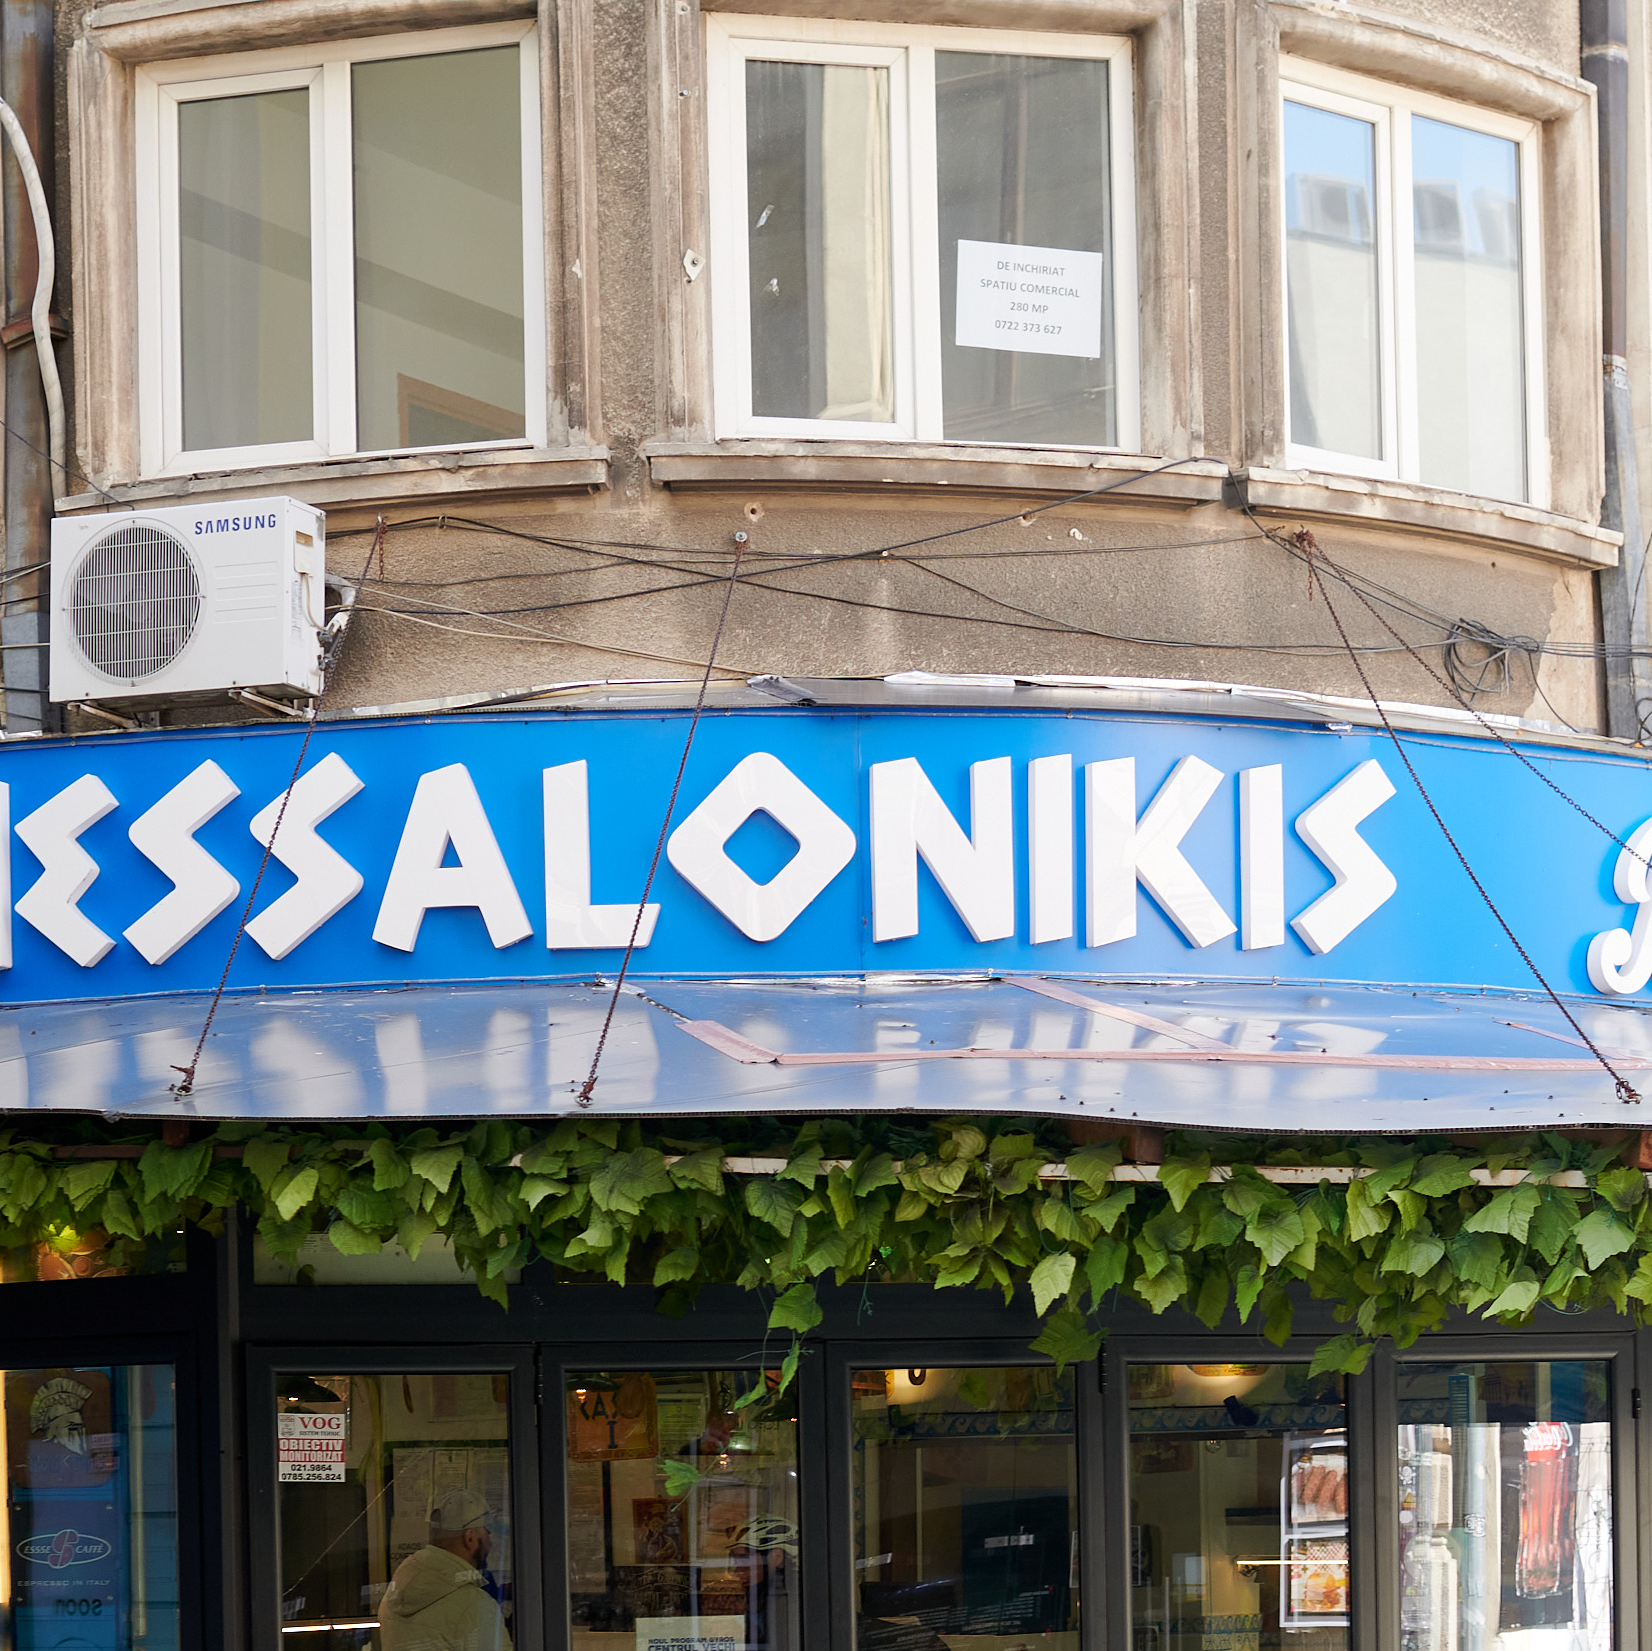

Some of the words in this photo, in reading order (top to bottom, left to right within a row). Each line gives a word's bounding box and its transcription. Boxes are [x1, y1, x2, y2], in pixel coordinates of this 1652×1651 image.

[997, 261, 1010, 271] DE
[1013, 263, 1065, 276] INCHIRIAT
[980, 279, 1017, 291] SPATIU
[1020, 283, 1080, 298] COMERCIAL
[1010, 302, 1029, 311] 280
[1032, 304, 1049, 314] MP
[995, 320, 1019, 330] 0722
[1022, 323, 1041, 332] 373
[1044, 325, 1062, 335] 627
[195, 514, 276, 535] SAMSUNG
[298, 1417, 341, 1430] VOG
[279, 1440, 343, 1451] OBIECTIV
[279, 1451, 343, 1462] MONITORIZAT
[23, 1545, 51, 1554] ESSSE
[17, 1579, 69, 1587] ESPRESSO
[702, 1643, 735, 1651] VECHI
